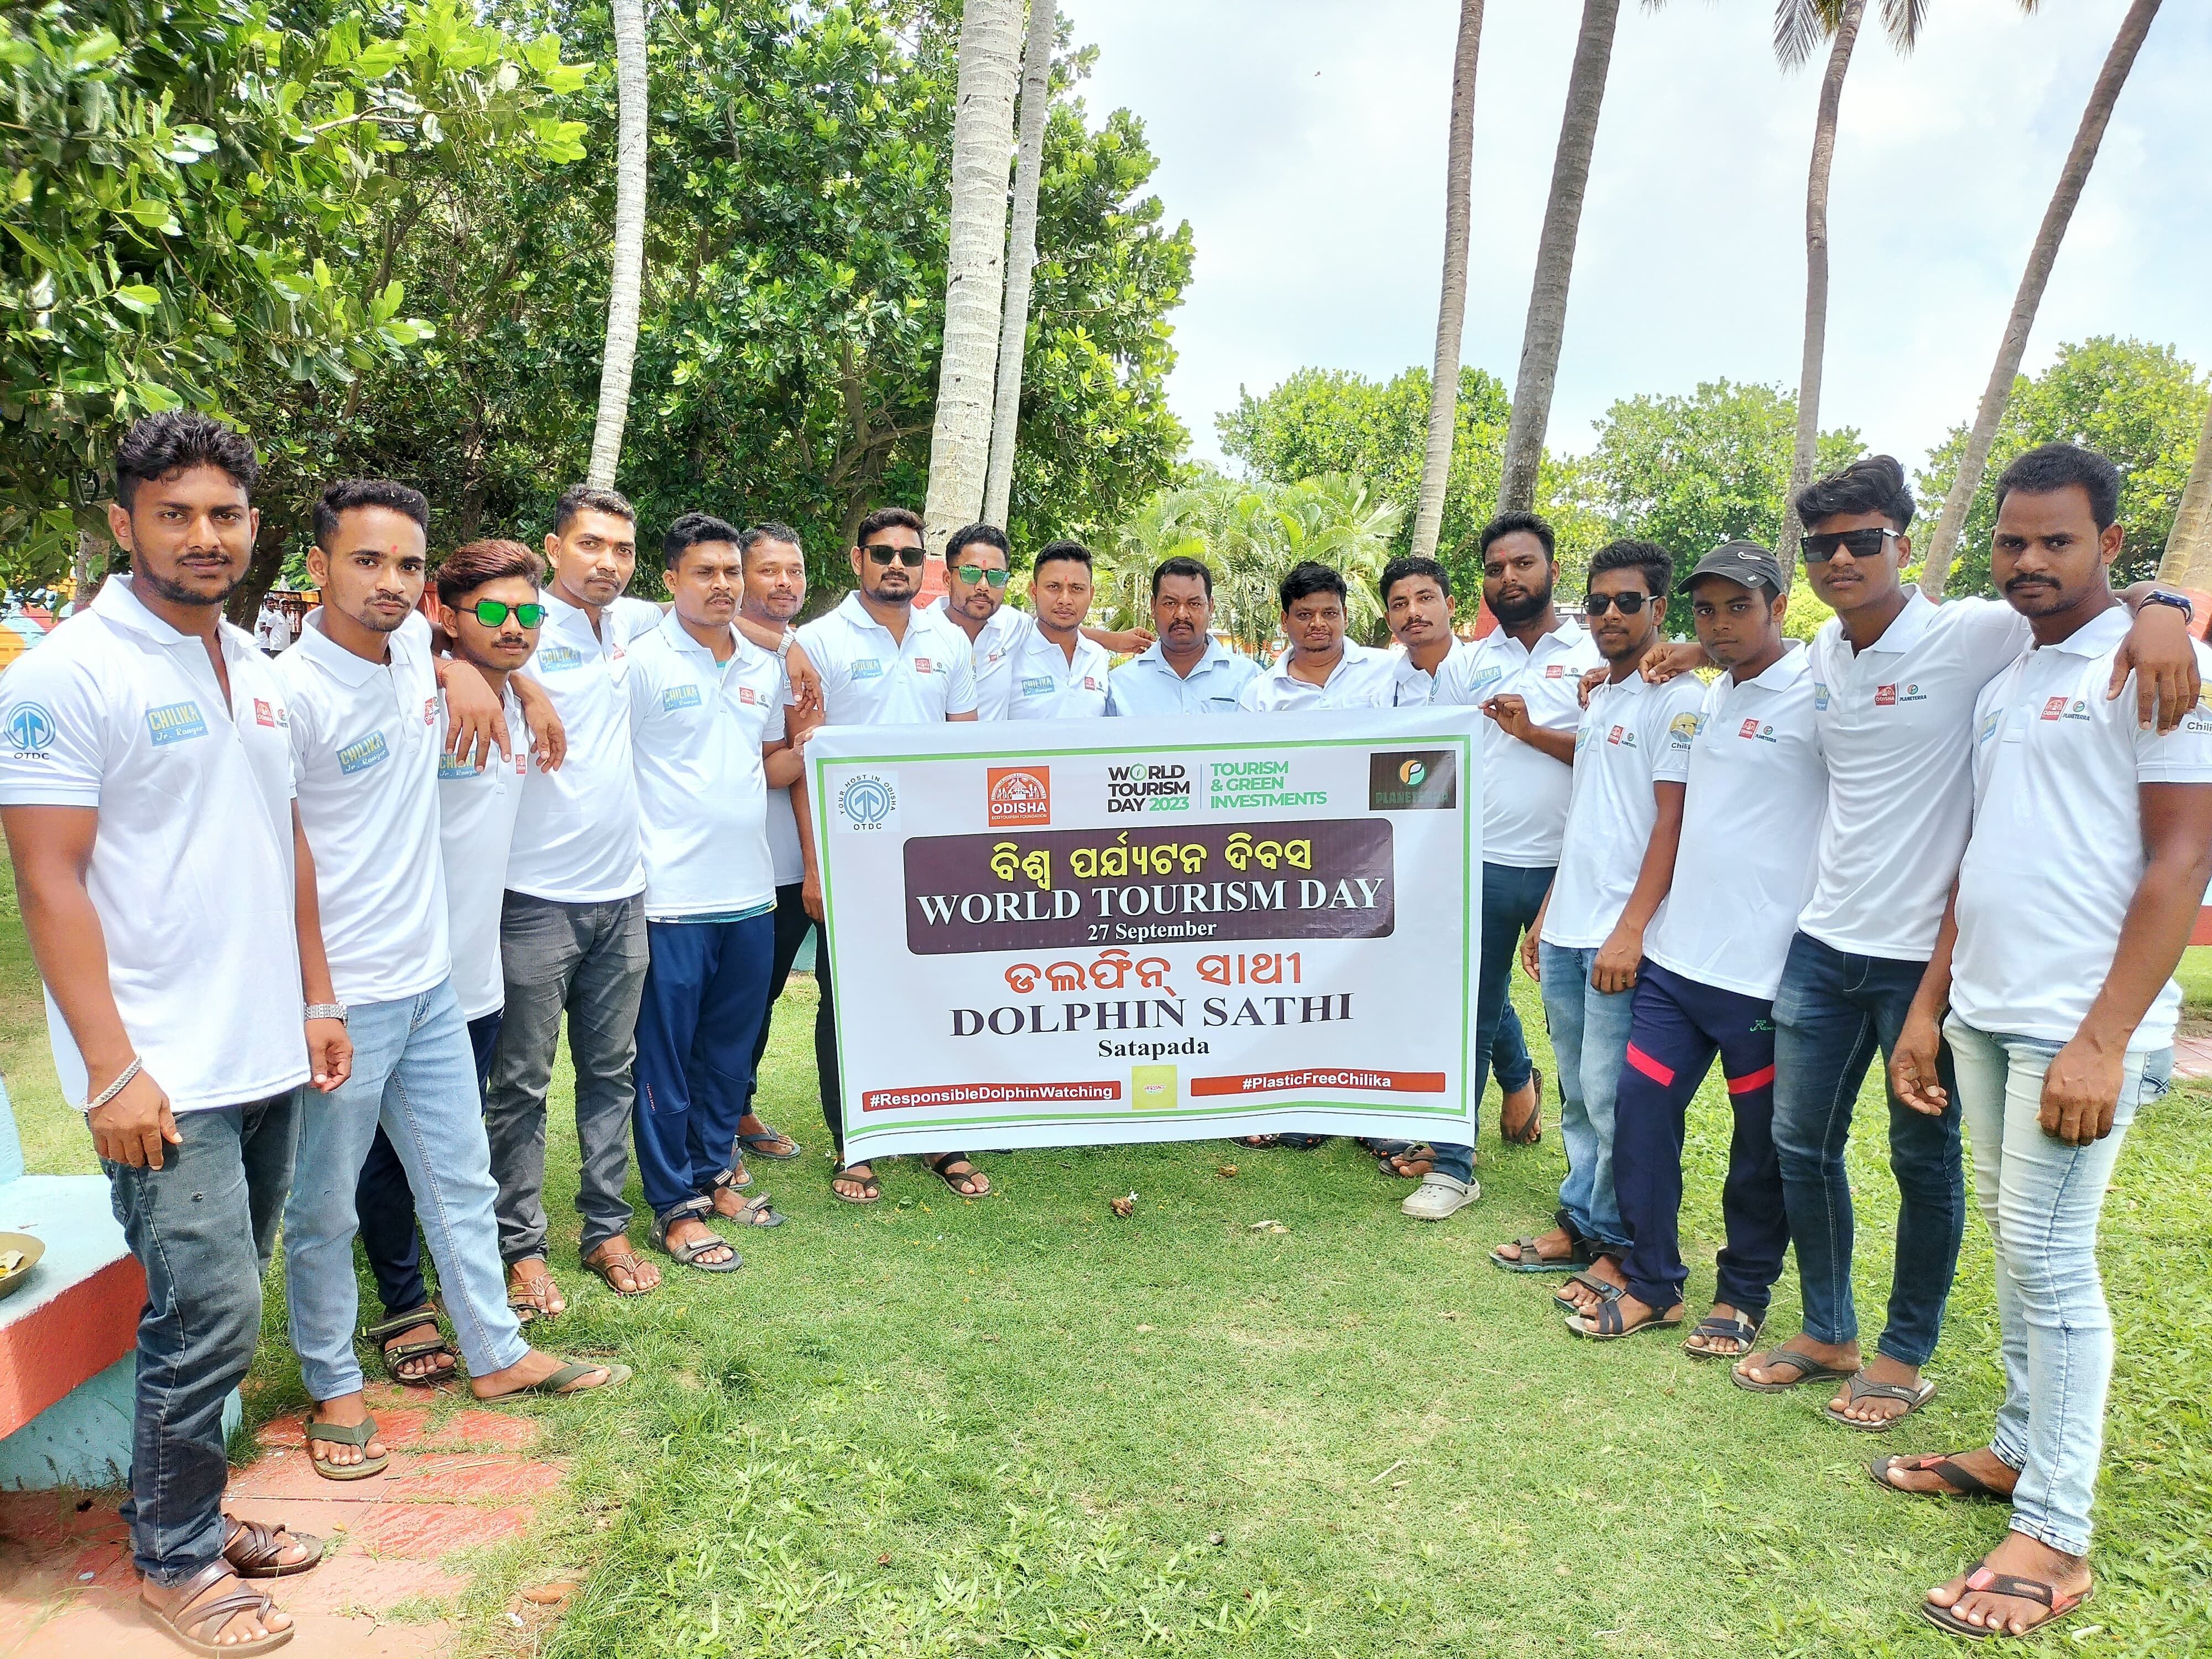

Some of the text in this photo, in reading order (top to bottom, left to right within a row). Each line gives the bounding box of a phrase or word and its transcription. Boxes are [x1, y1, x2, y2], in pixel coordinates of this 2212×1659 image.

[664, 687, 697, 702] CHILIKA
[149, 705, 201, 732] CHILIKA
[2063, 712, 2090, 721] PLANETERRA
[175, 726, 204, 736] Ranger
[2187, 722, 2212, 732] Chili
[339, 733, 385, 766] CHILIKA
[1108, 763, 1185, 782] WORLD
[1210, 761, 1288, 777] TOURISM
[844, 774, 867, 787] HOST
[884, 782, 896, 811] ODISHA
[1108, 781, 1190, 799] TOURISM
[1211, 776, 1284, 792] & GREEN
[991, 801, 1047, 814] ODISHA
[1108, 796, 1190, 813] DAY 2023
[1210, 791, 1327, 810] INVESTMENTS
[1224, 832, 1312, 871] ଦିବସ
[916, 877, 1385, 926] WORLD TOURISM DAY
[1088, 921, 1218, 943] 27 September
[949, 992, 1355, 1036] DOLPHIN SATHI
[1098, 1037, 1210, 1060] Satapada
[1242, 1071, 1391, 1090] #PlasticFreeChilika
[869, 1084, 1113, 1107] #ResponsibleDolphinWatching
